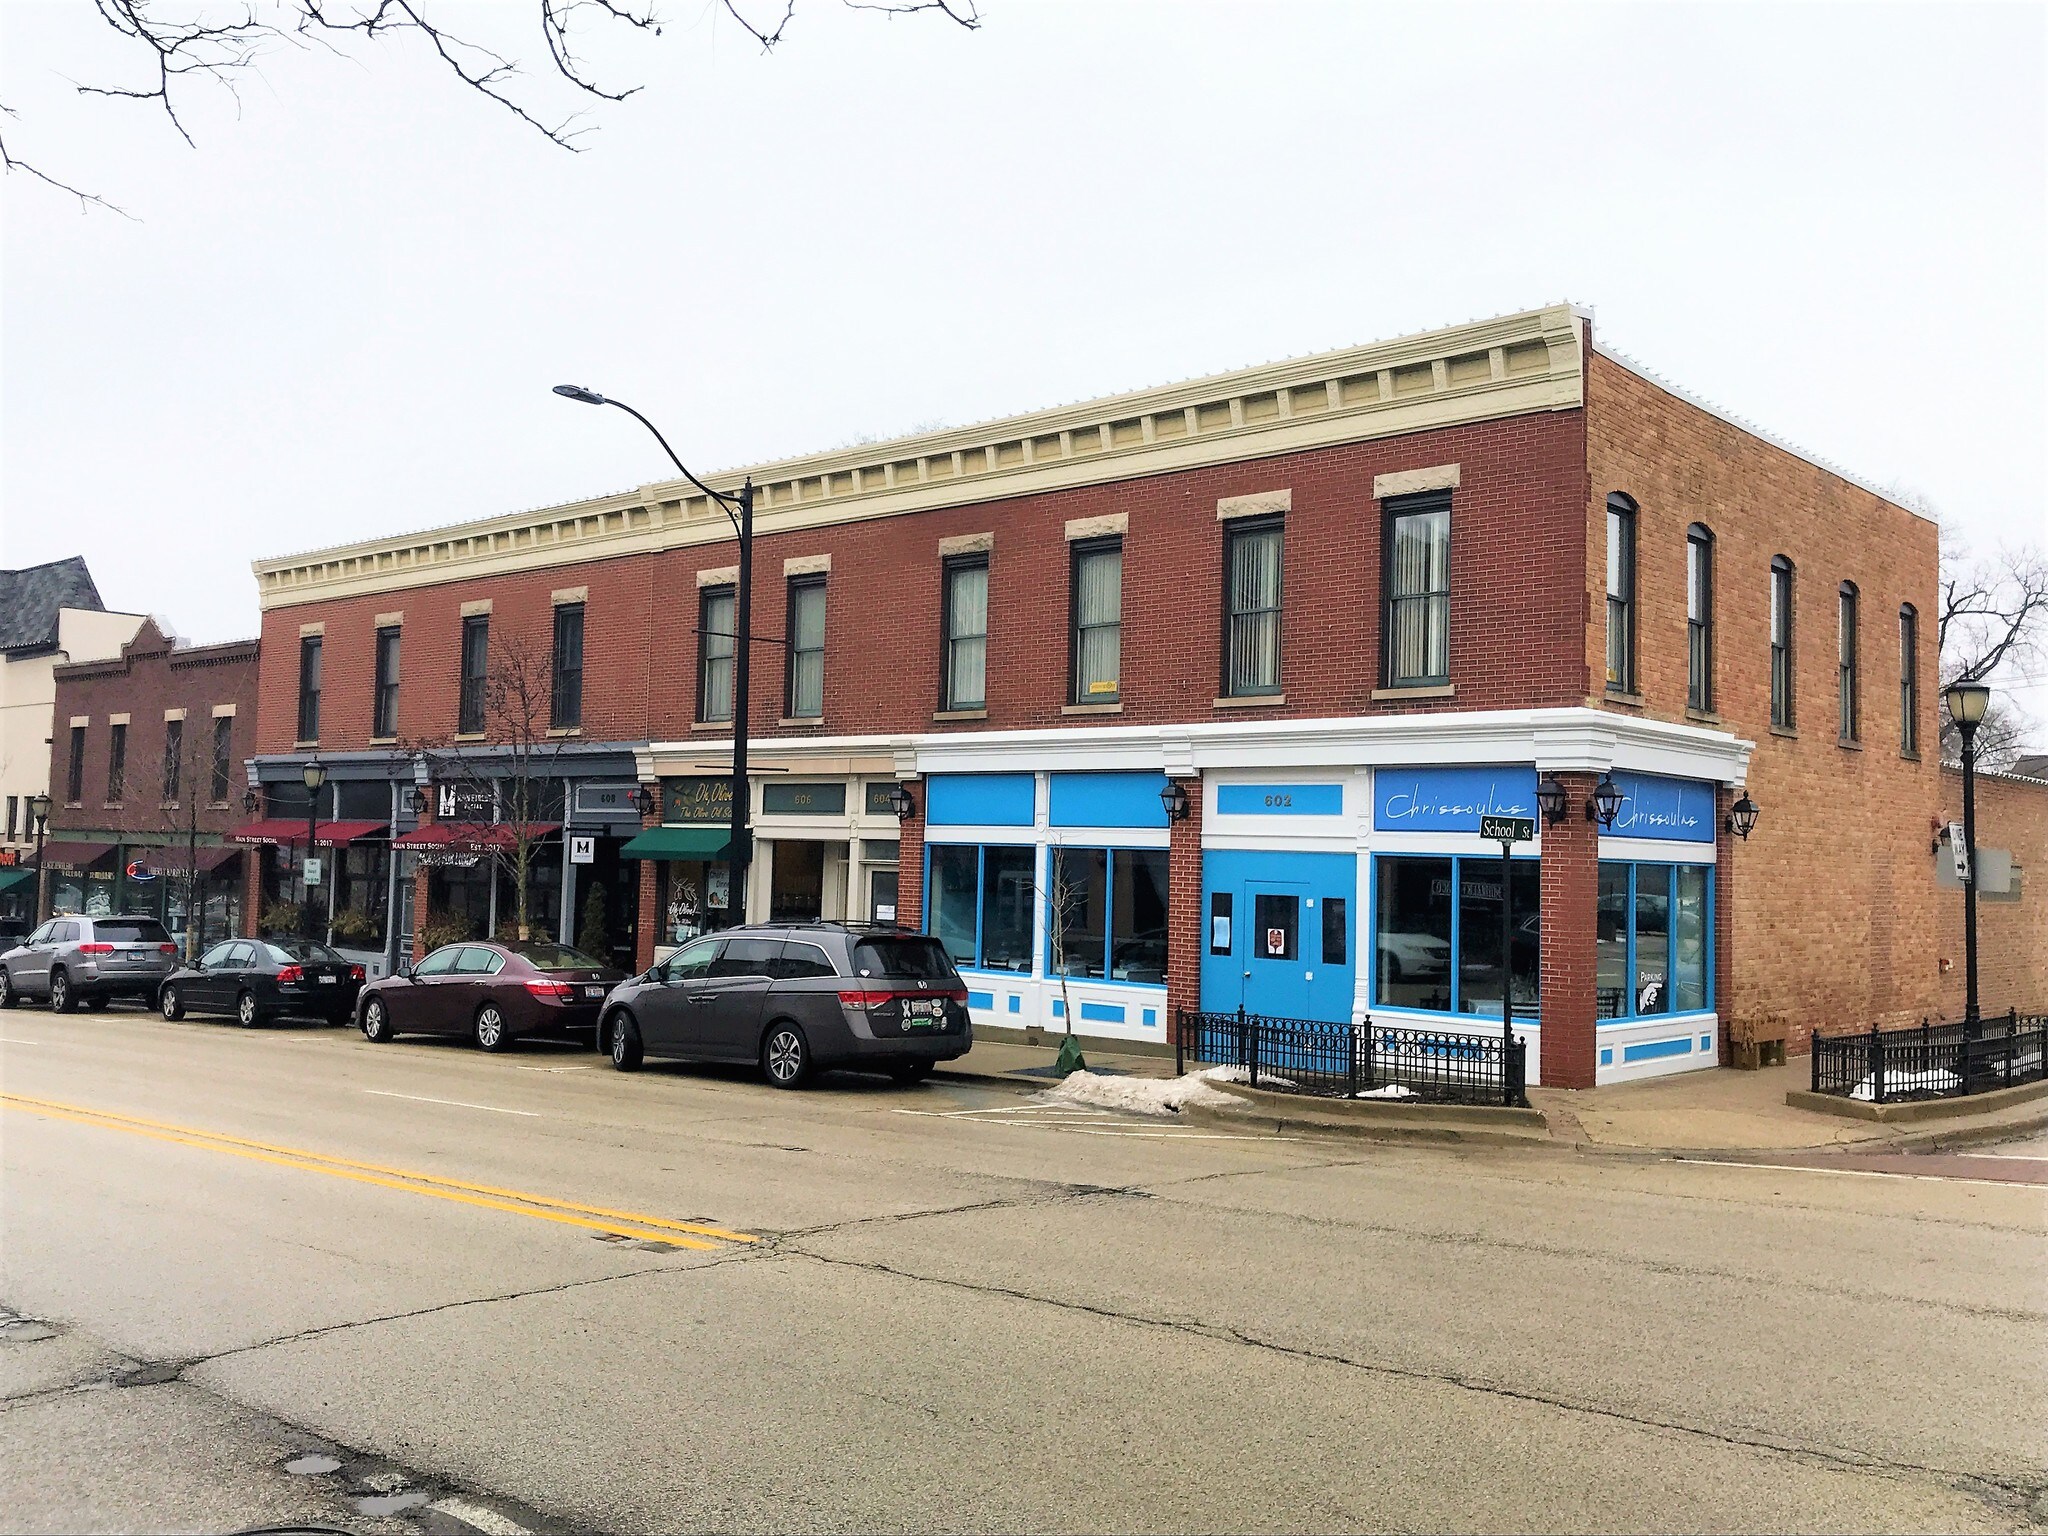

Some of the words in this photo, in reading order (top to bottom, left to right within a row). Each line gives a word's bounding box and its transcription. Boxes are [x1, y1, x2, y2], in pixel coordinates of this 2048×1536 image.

[600, 793, 616, 803] 608
[794, 794, 812, 805] 606
[873, 793, 891, 804] 604
[1264, 795, 1292, 807] 602
[1384, 783, 1528, 819] Chrissoulas
[1616, 782, 1699, 829] Chrissoulas
[680, 806, 691, 818] The
[693, 806, 709, 818] Olive
[1483, 819, 1516, 838] School
[1521, 826, 1531, 838] St
[320, 839, 333, 847] 2017
[392, 842, 406, 850] MAIN
[406, 842, 426, 850] STREET
[577, 840, 590, 854] M
[1640, 971, 1662, 983] PARKING
